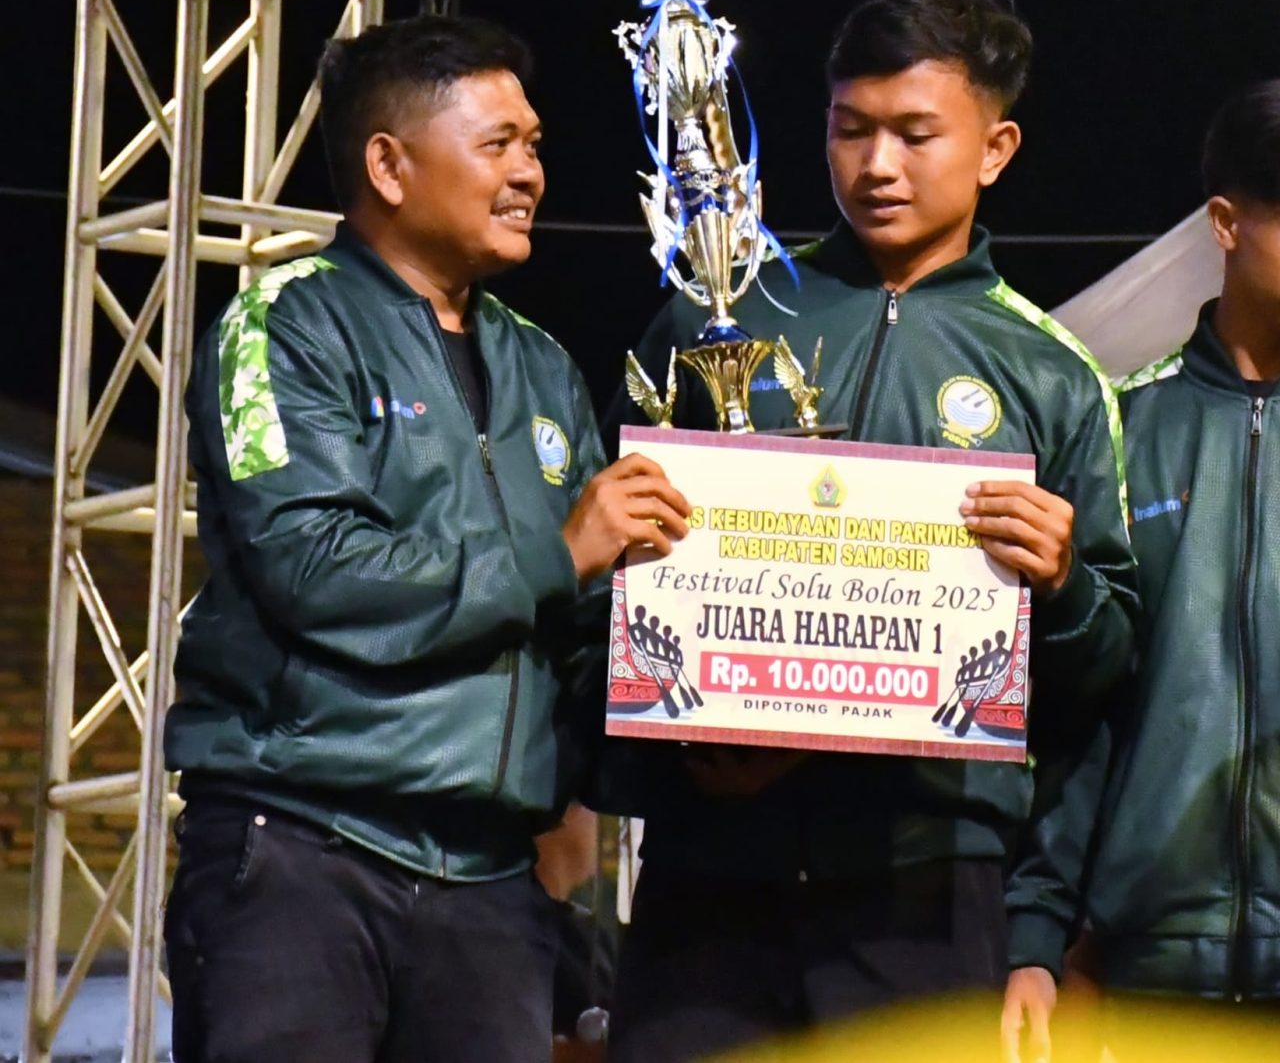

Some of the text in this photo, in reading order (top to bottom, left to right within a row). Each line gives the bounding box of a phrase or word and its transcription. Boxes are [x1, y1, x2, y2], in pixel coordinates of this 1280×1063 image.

[709, 507, 840, 538] KEBUDAYAAN
[844, 517, 885, 542] DAN
[889, 520, 979, 549] PARIWIS
[719, 535, 930, 572] KABUPATEN SAMOSIR
[653, 566, 999, 611] Festival Solu Bolon 2025
[696, 604, 942, 654] JUARA HARAPAN 1
[710, 655, 929, 699] Rp. 10.000.000
[744, 699, 893, 718] DIPOTONG PAJAK
